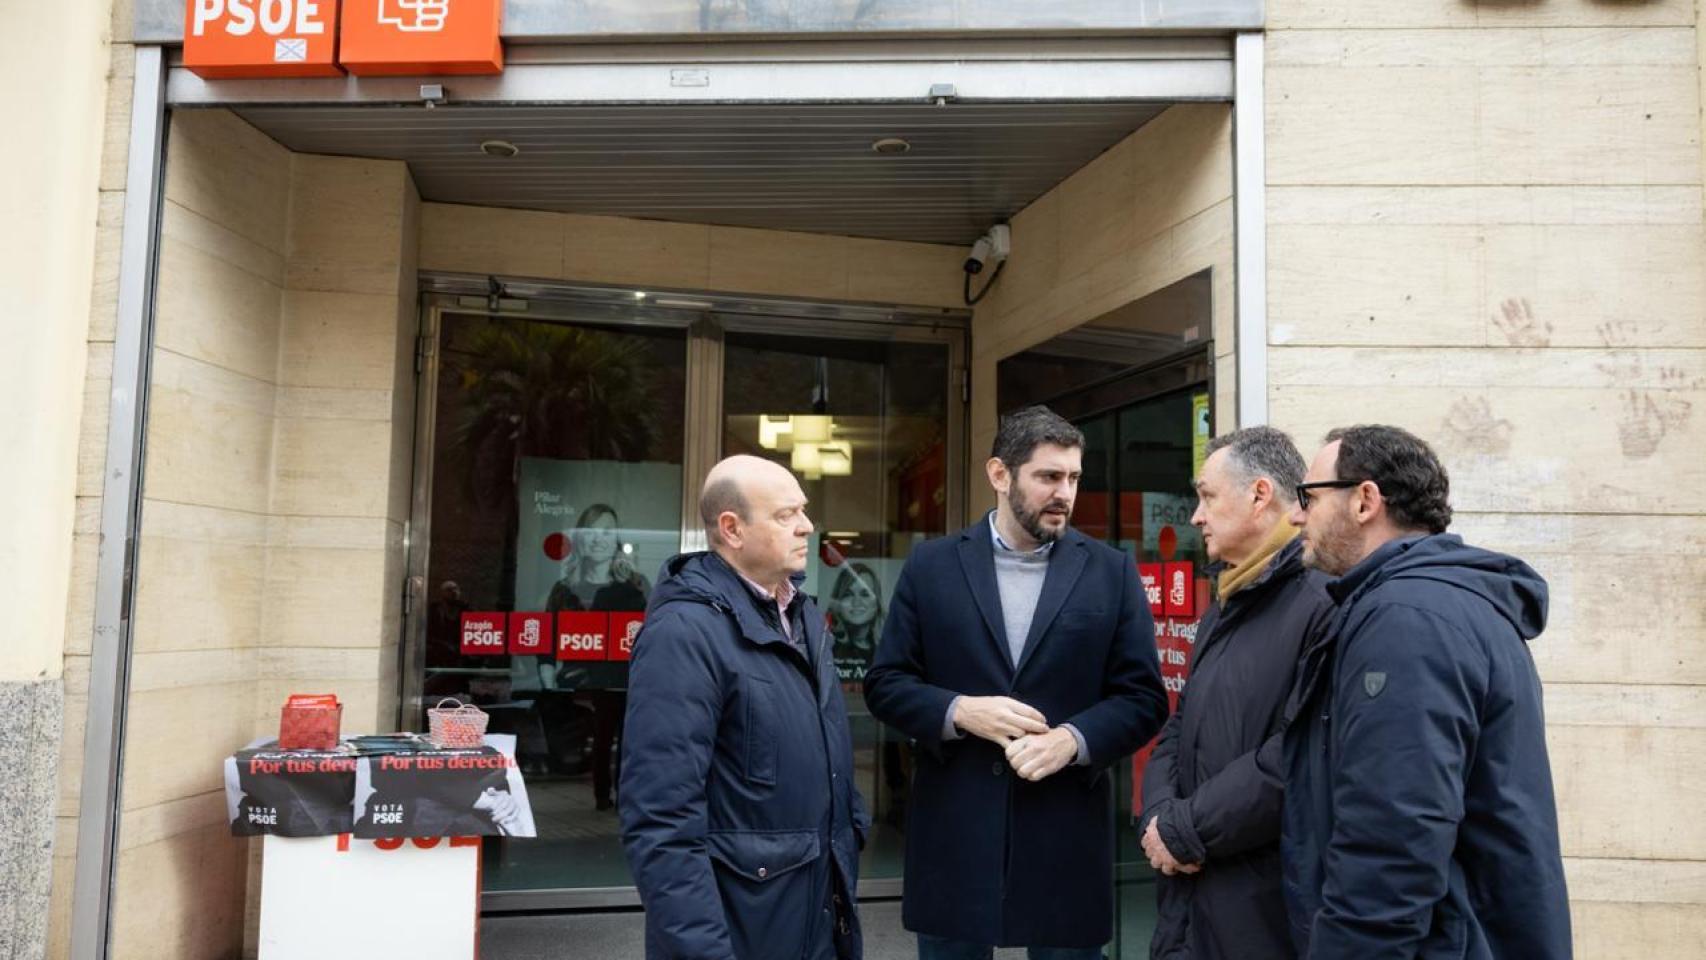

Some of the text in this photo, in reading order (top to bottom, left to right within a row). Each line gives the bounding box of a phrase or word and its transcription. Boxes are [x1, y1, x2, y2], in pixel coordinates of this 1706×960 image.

[193, 0, 325, 36] PSOE
[463, 631, 503, 646] PSOE
[1153, 618, 1201, 644] or Arag
[560, 634, 604, 650] PSOE
[1167, 648, 1186, 665] tus
[250, 757, 357, 774] Por tus dere
[381, 756, 413, 771] Por
[416, 754, 445, 769] tus
[374, 804, 403, 812] VOTA
[248, 814, 277, 825] PSOE
[373, 812, 403, 824] PSOE
